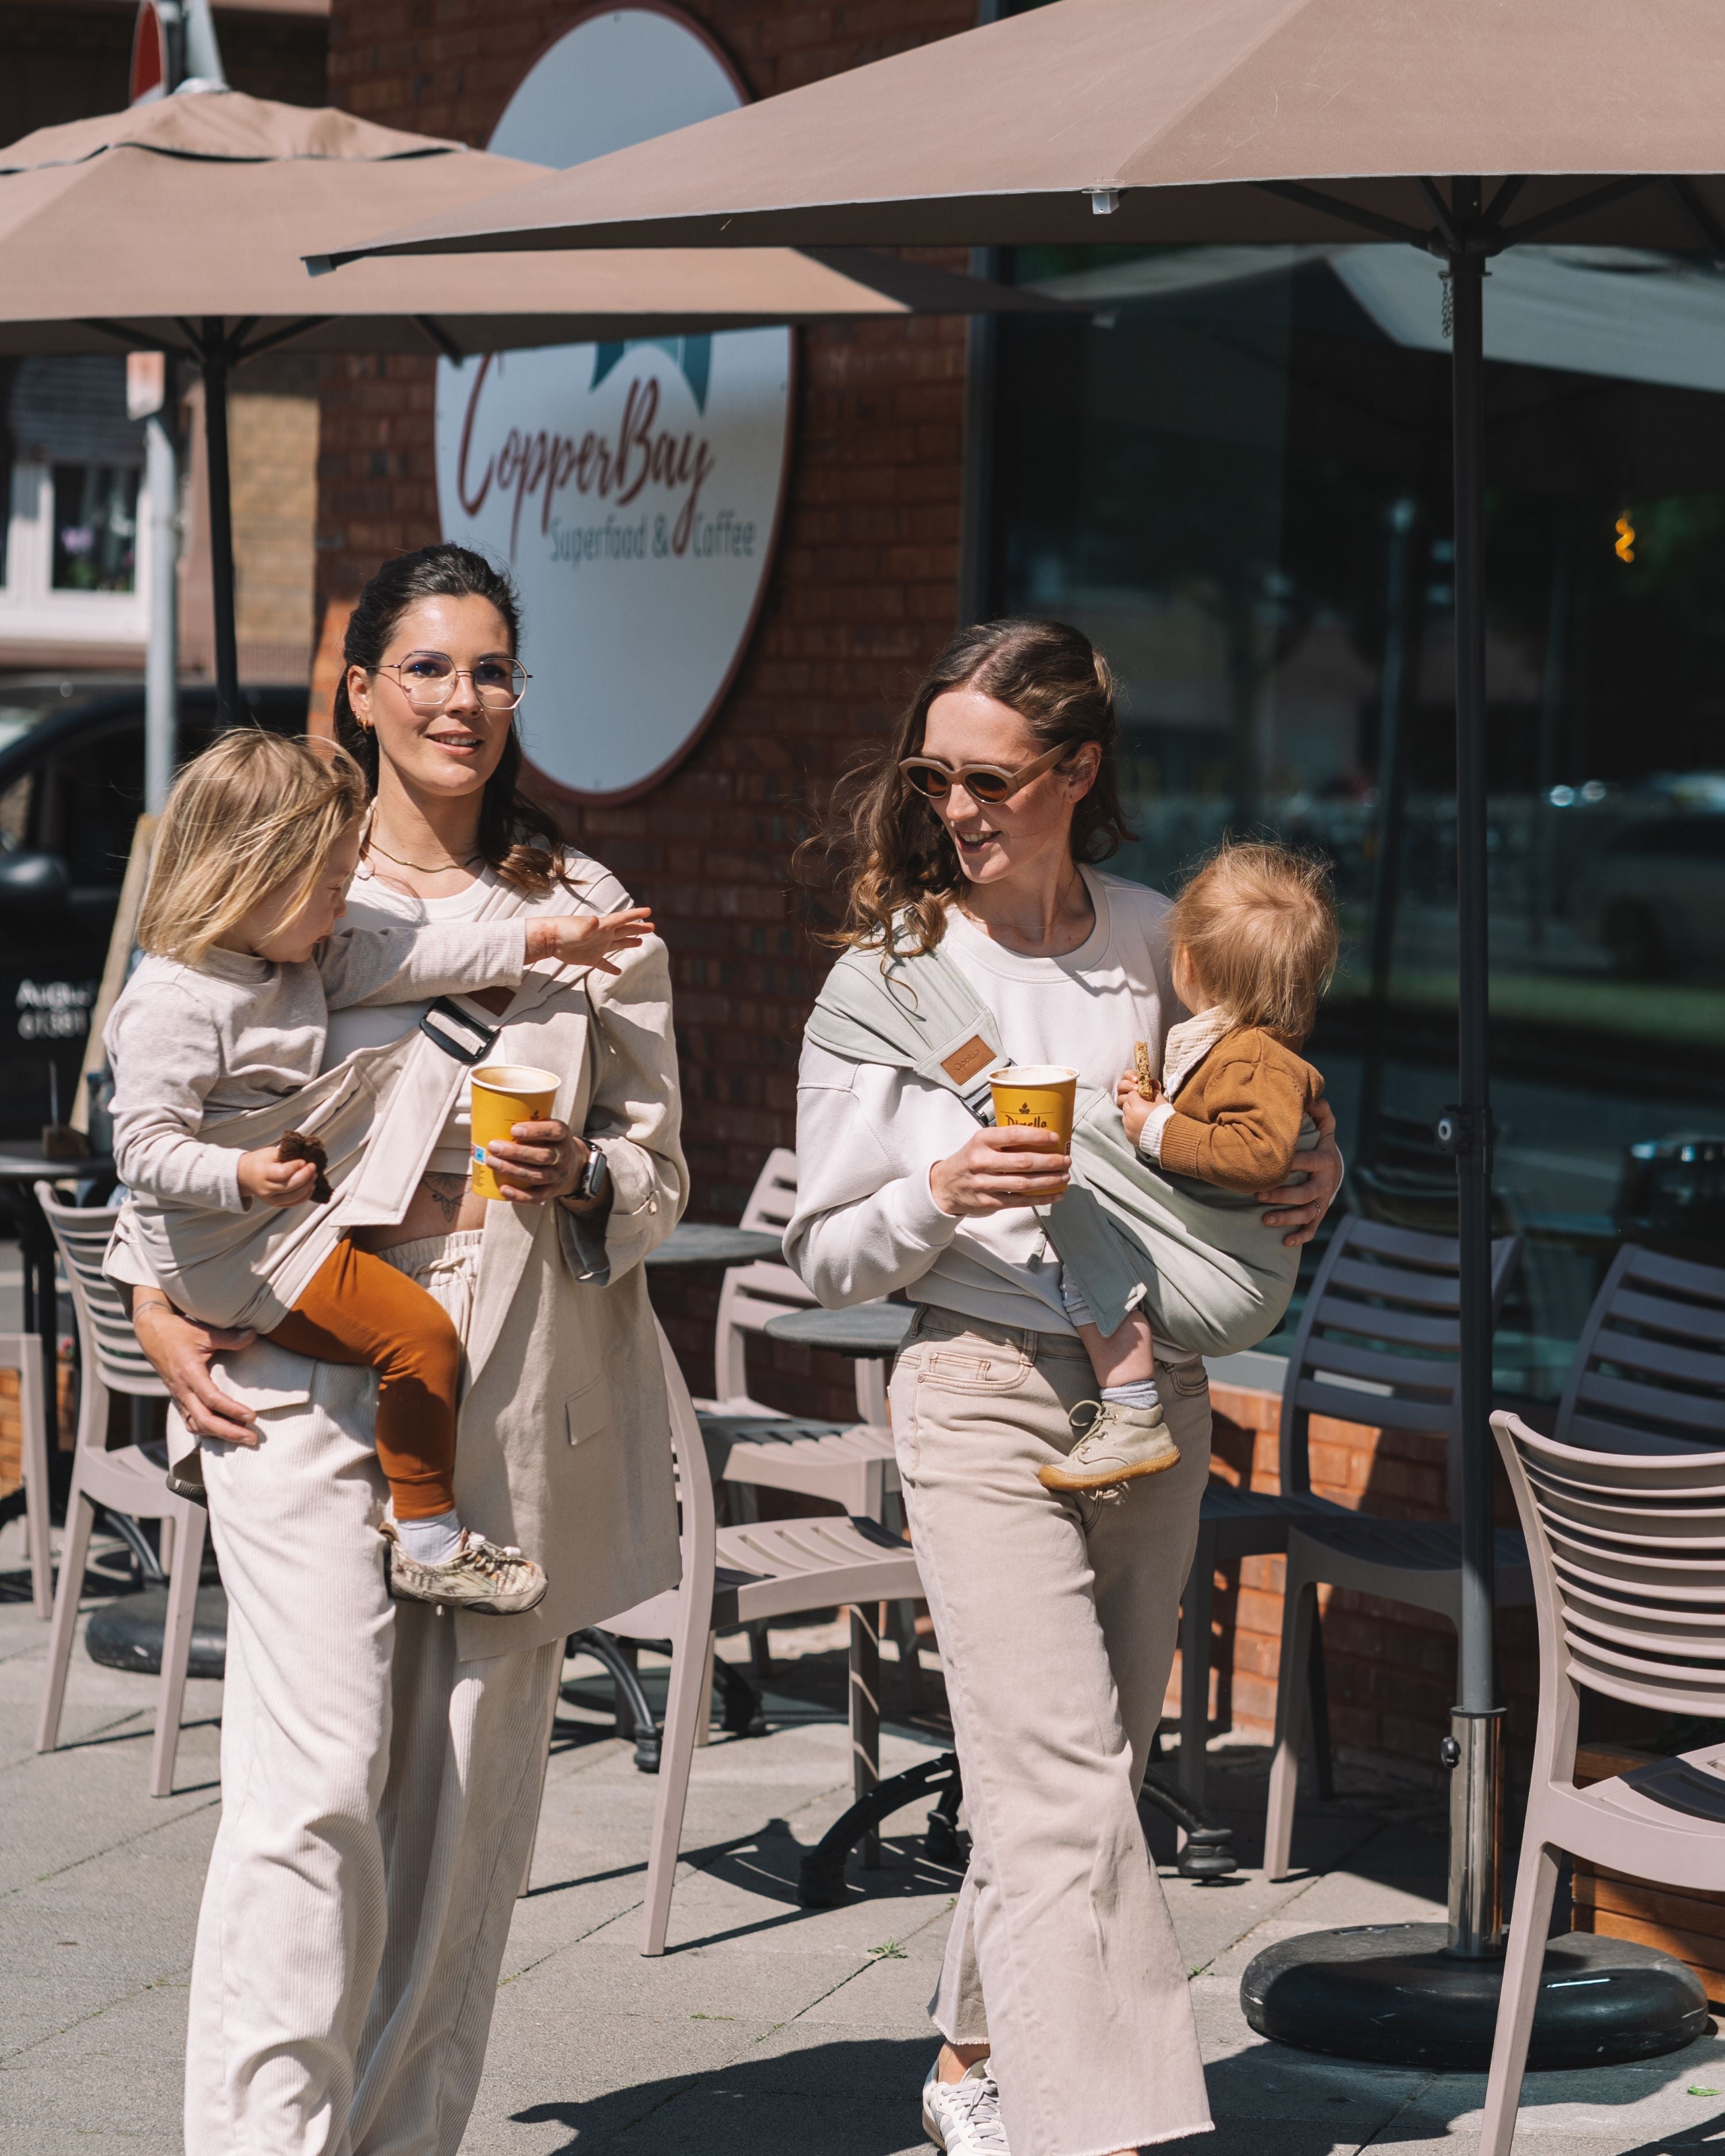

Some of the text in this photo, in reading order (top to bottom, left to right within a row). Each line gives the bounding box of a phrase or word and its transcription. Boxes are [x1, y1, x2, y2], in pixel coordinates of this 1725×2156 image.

[551, 509, 755, 567] Superfood & Coffee
[954, 1049, 980, 1071] Qookie
